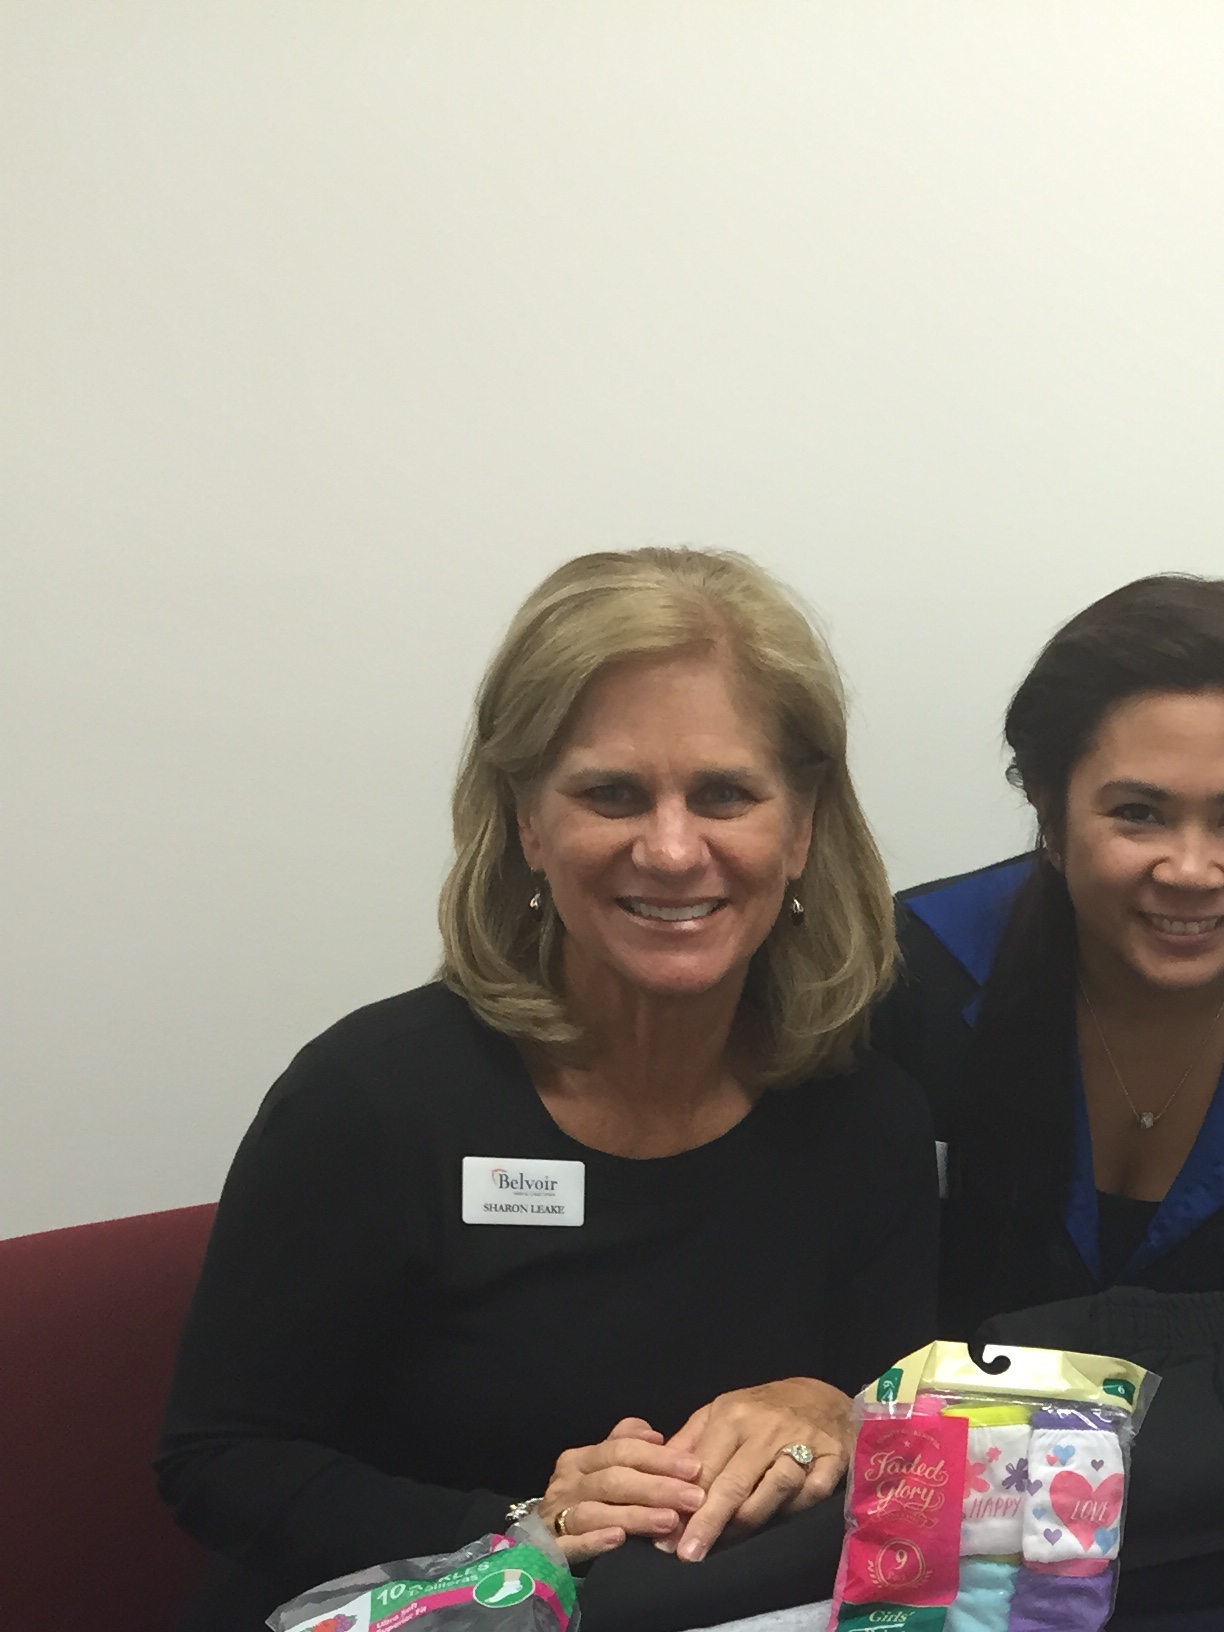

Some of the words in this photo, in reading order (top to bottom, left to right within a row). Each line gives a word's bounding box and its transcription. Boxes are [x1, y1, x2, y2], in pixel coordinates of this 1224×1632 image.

[498, 1172, 558, 1191] Belvoir
[483, 1203, 528, 1214] SHARON
[530, 1204, 565, 1215] LEAKE
[865, 1450, 949, 1484] Faded
[868, 1479, 945, 1514] Glory
[968, 1498, 1022, 1519] HAPPY
[1070, 1499, 1109, 1521] LOVE
[895, 1549, 908, 1570] 9
[377, 1583, 407, 1606] 10
